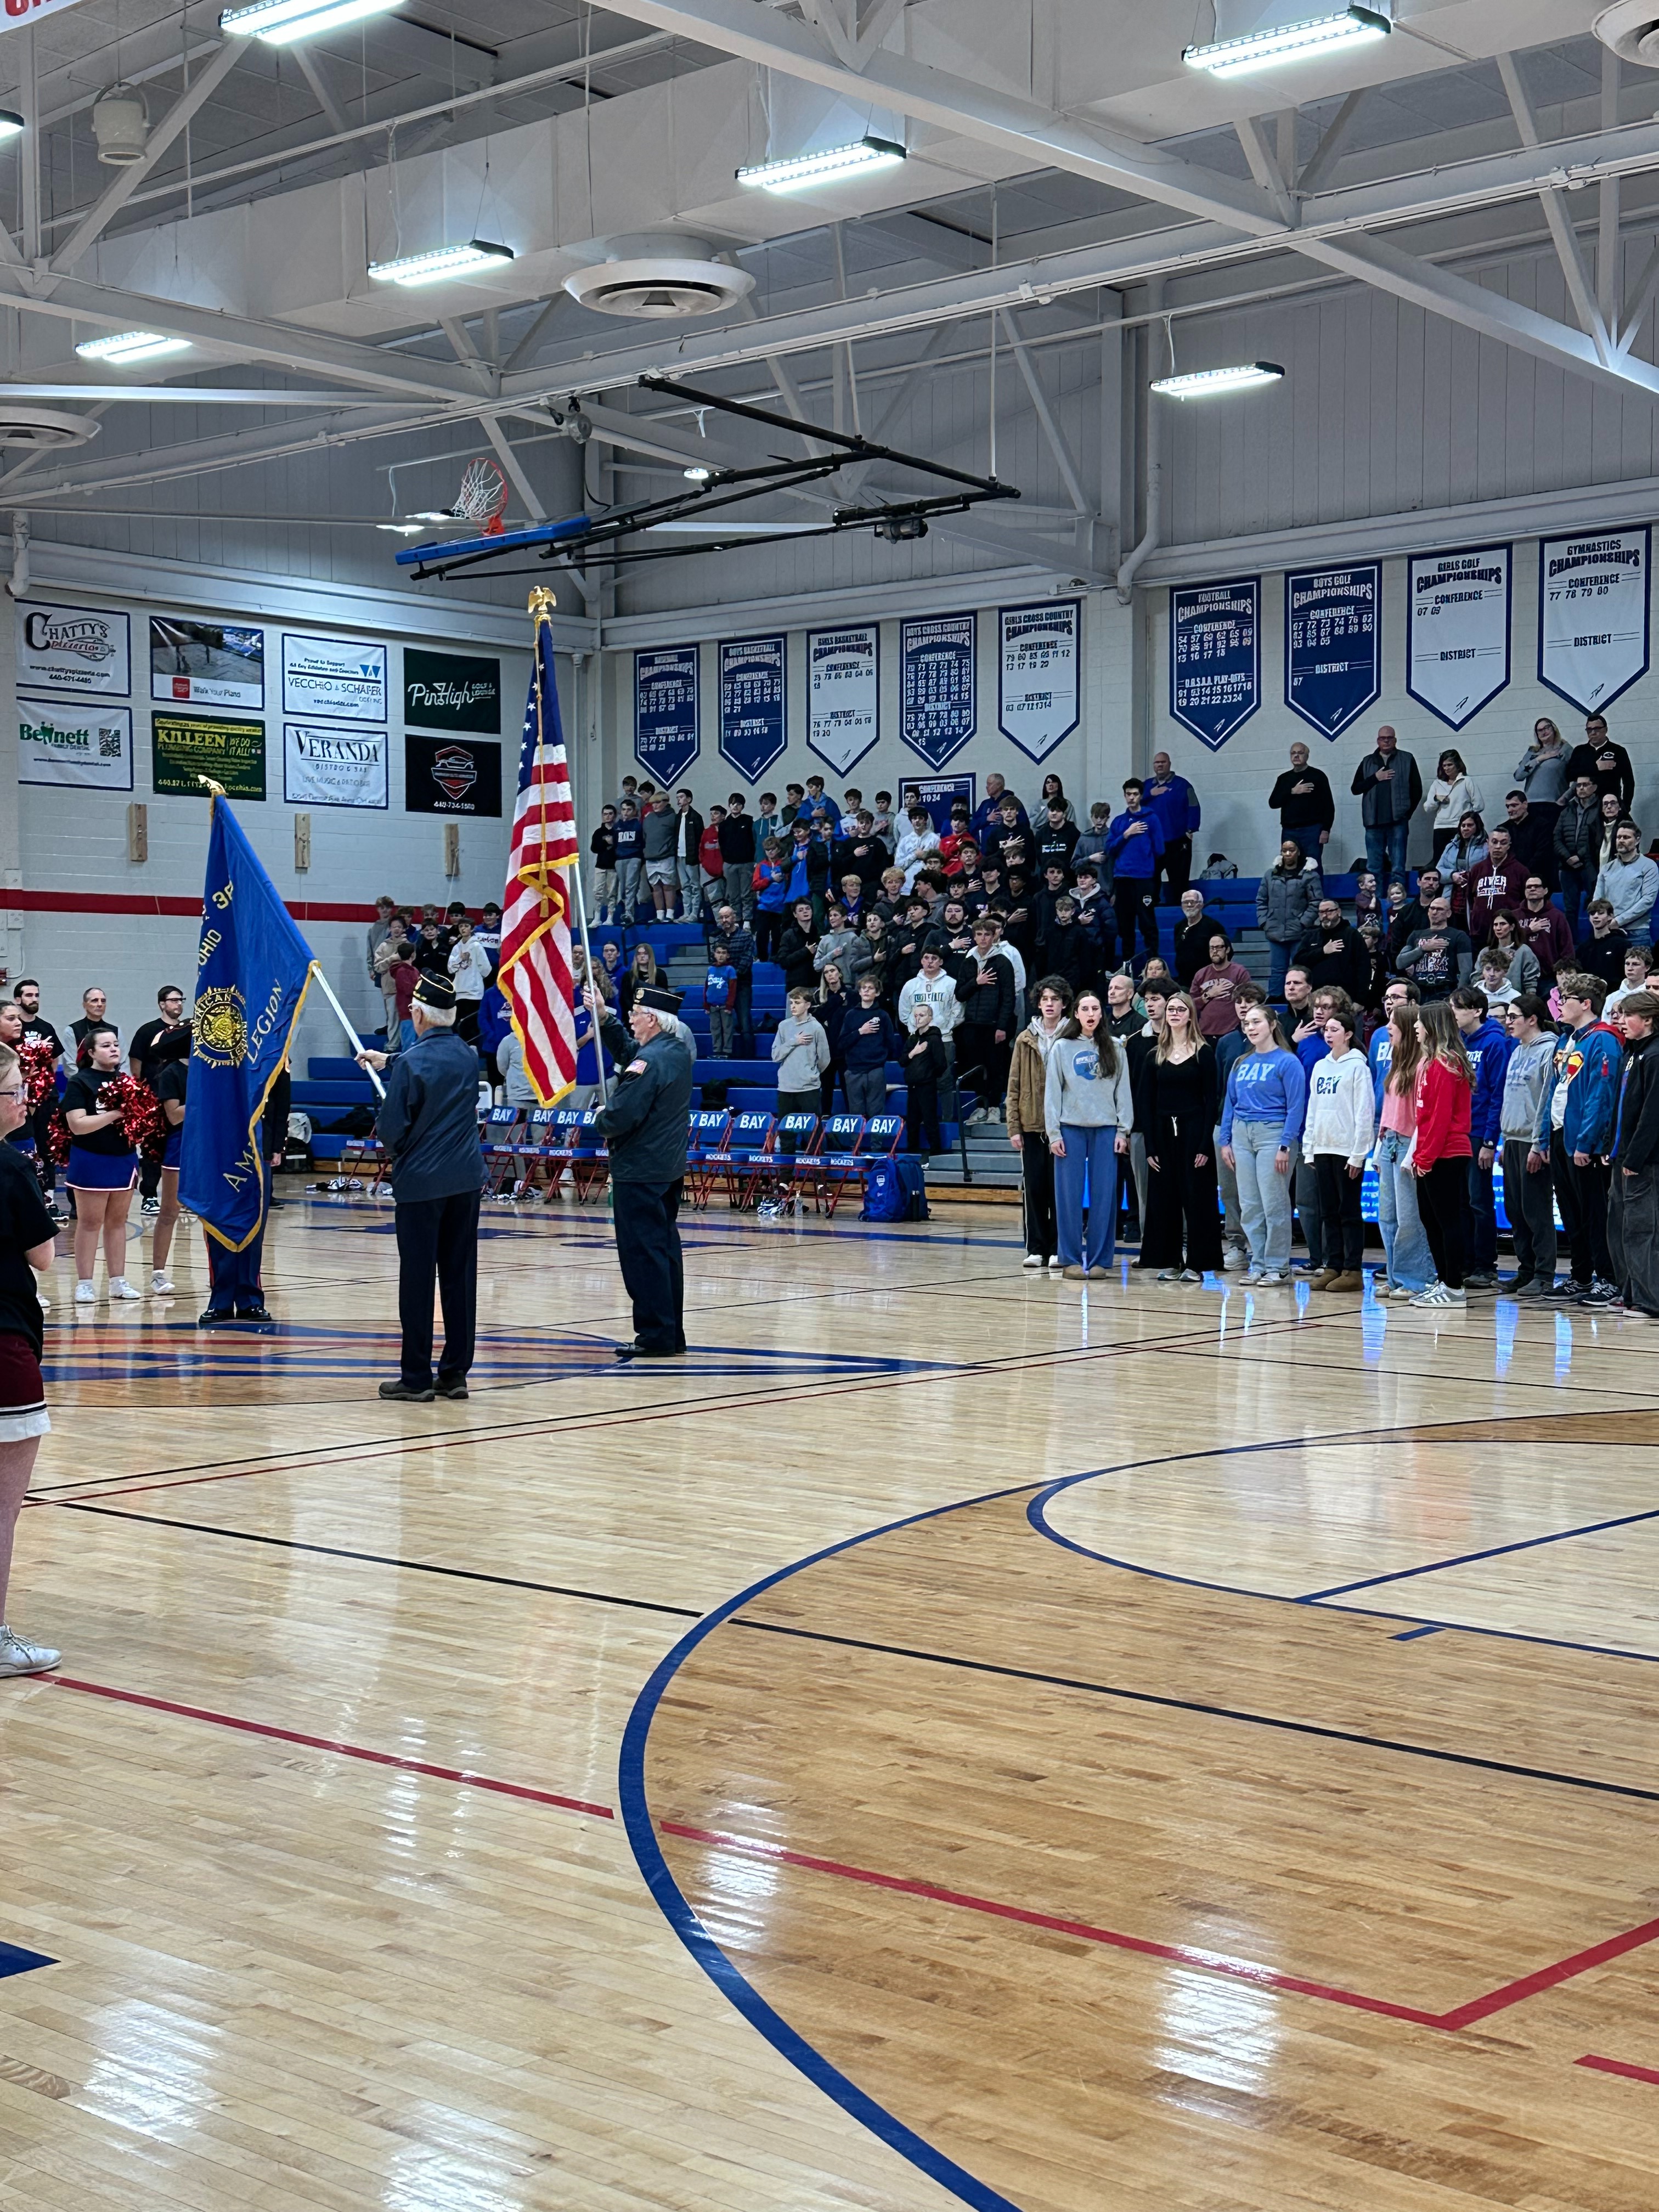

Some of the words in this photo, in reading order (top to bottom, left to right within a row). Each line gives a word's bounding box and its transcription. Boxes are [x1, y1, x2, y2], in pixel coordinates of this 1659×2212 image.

[1567, 540, 1621, 555] GYMNASTICS
[1438, 561, 1460, 572] GIRLS
[1462, 558, 1480, 569] GOLF
[1549, 549, 1640, 577] CHAMPIONSHIPS
[1313, 577, 1332, 588] BOYS
[1334, 575, 1352, 585] GOLF
[1417, 567, 1502, 594] CHAMPIONSHIPS
[1568, 574, 1620, 588] CONFERENCE
[1198, 590, 1231, 603] FOOTBALL
[1294, 583, 1373, 609] CHAMPIONSHIPS
[1435, 590, 1483, 605] CONFERENCE
[1550, 591, 1561, 601] 77
[1566, 590, 1576, 599] 78
[1023, 613, 1043, 623] CROSS
[1045, 610, 1073, 621] COUNTRY
[1178, 598, 1252, 622] CHAMPIONSHIPS
[1310, 606, 1355, 619] CONFERENCE
[1006, 620, 1072, 642] CHAMPIONSHIPS
[1194, 620, 1235, 633] CONFERENCE
[907, 632, 970, 652] CHAMPIONSHIPS
[1574, 634, 1612, 647] DISTRICT
[814, 642, 872, 662] CHAMPIONSHIPS
[920, 651, 956, 663] CONFERENCE
[1441, 648, 1476, 661] DISTRICT
[1316, 662, 1349, 674] DISTRICT
[289, 677, 332, 691] VECCHIO
[1189, 697, 1199, 706] 20
[1201, 696, 1210, 704] 21
[1211, 696, 1221, 704] 22
[1222, 695, 1232, 703] 23
[1232, 693, 1242, 702] 24
[20, 721, 89, 746] Bennett
[157, 730, 227, 747] KILLEEN
[295, 730, 379, 761] VERANDA
[932, 793, 940, 802] 24
[198, 929, 222, 966] OHIO
[247, 978, 283, 1064] LEGION
[1236, 1063, 1276, 1082] BAY
[1317, 1076, 1342, 1094] BAY
[492, 1108, 512, 1121] BAY
[533, 1110, 554, 1122] BAY
[557, 1111, 579, 1124] BAY
[699, 1114, 724, 1127] BAY
[740, 1115, 766, 1128] BAY
[785, 1116, 811, 1129] BAY
[832, 1118, 858, 1132] BAY
[871, 1118, 896, 1133] BAY
[749, 1154, 773, 1163] ROCKETS
[223, 1142, 254, 1192] AM
